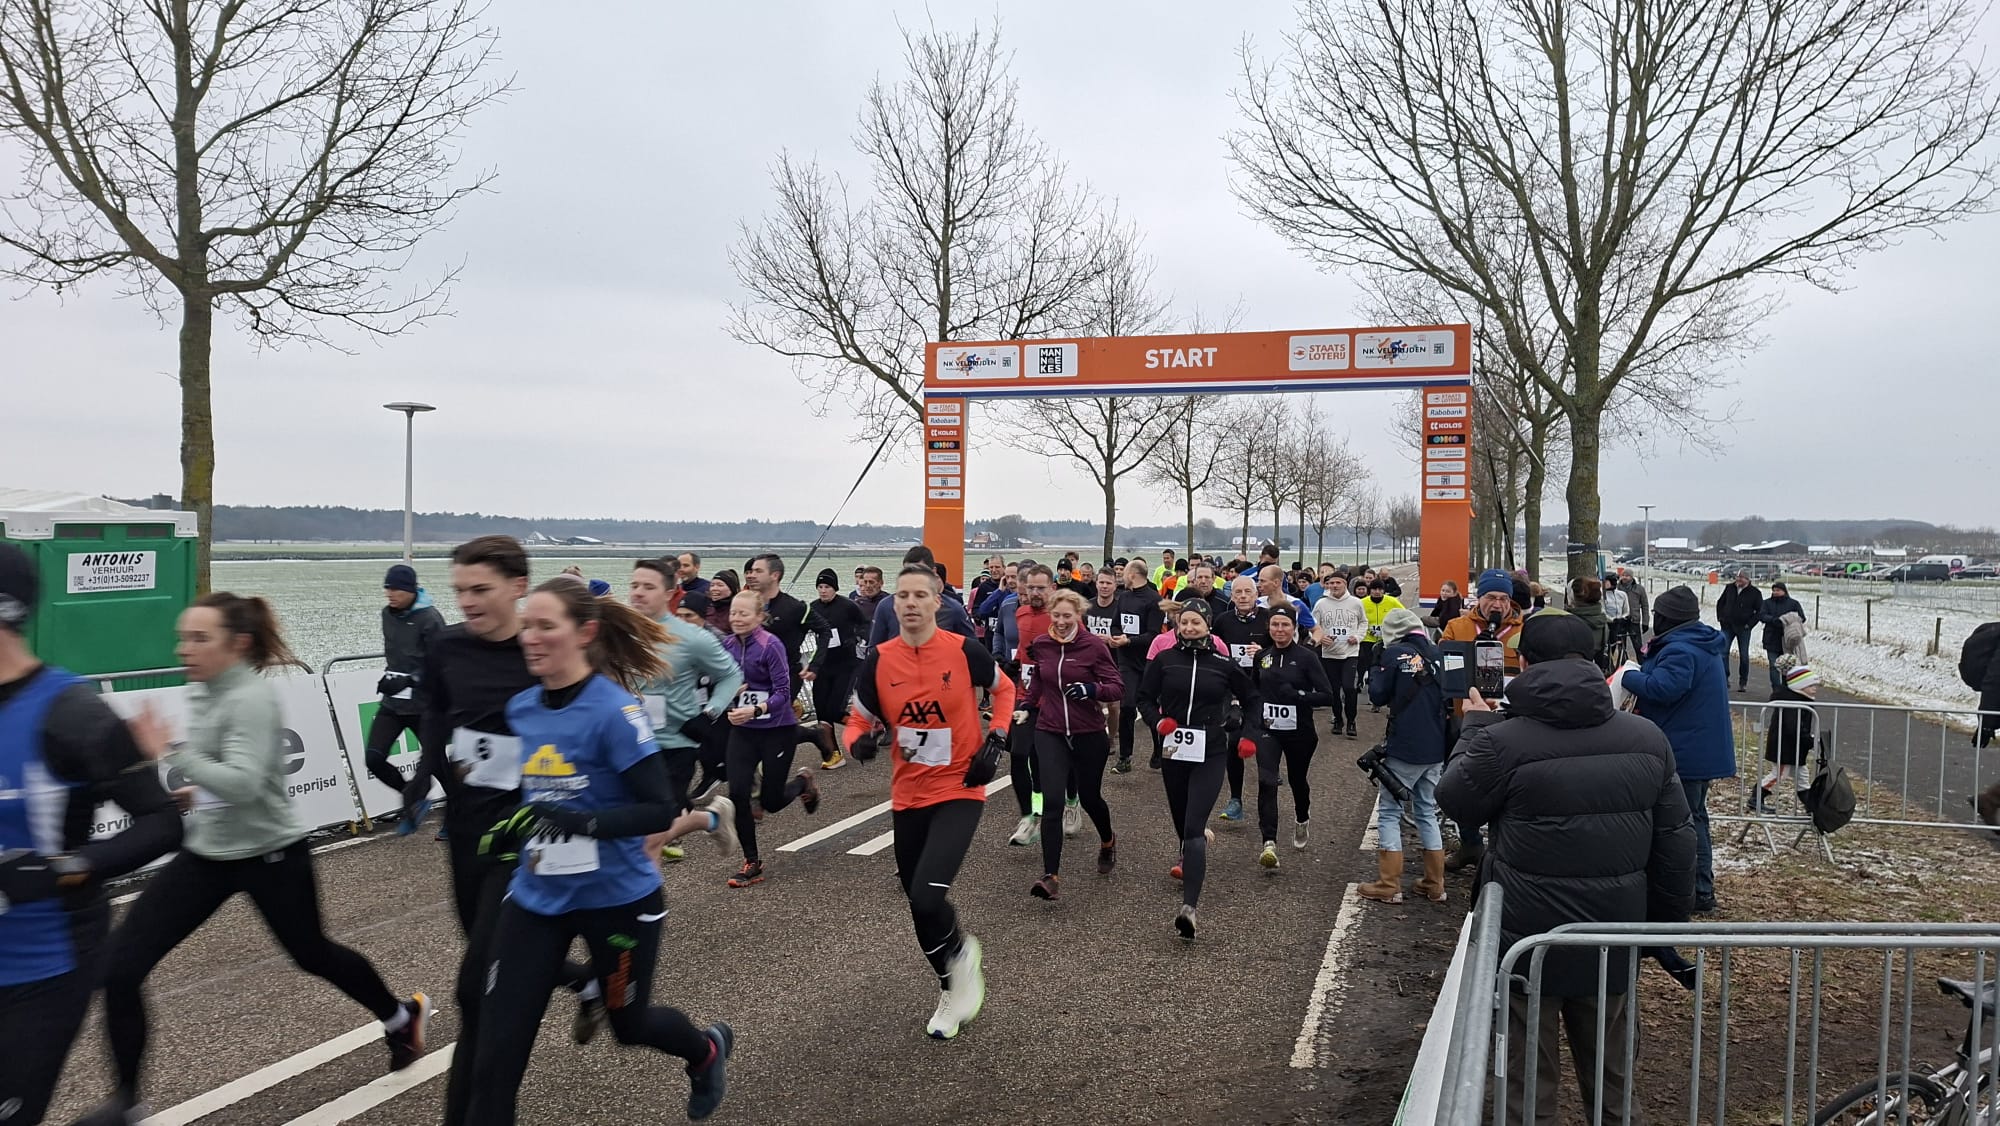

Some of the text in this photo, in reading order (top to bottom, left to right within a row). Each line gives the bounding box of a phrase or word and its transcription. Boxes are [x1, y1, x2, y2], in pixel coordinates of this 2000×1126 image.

[1040, 348, 1062, 357] MAN
[1309, 344, 1346, 352] STAATS
[1145, 347, 1218, 369] START
[1309, 352, 1346, 361] LOTERIJ
[1040, 364, 1062, 373] KES
[1430, 408, 1462, 416] Rabobank
[82, 553, 144, 567] ANTONIS
[92, 565, 134, 575] VERHUUR
[88, 573, 150, 585] +31(0)13-5092237
[1123, 615, 1134, 625] 63
[1324, 608, 1356, 629] GAP
[1332, 628, 1347, 636] 139
[743, 693, 758, 706] 26
[896, 700, 947, 724] AXA
[1268, 705, 1290, 719] 110
[915, 731, 928, 747] 7
[1174, 730, 1195, 746] 99
[288, 775, 337, 798] geprijsd
